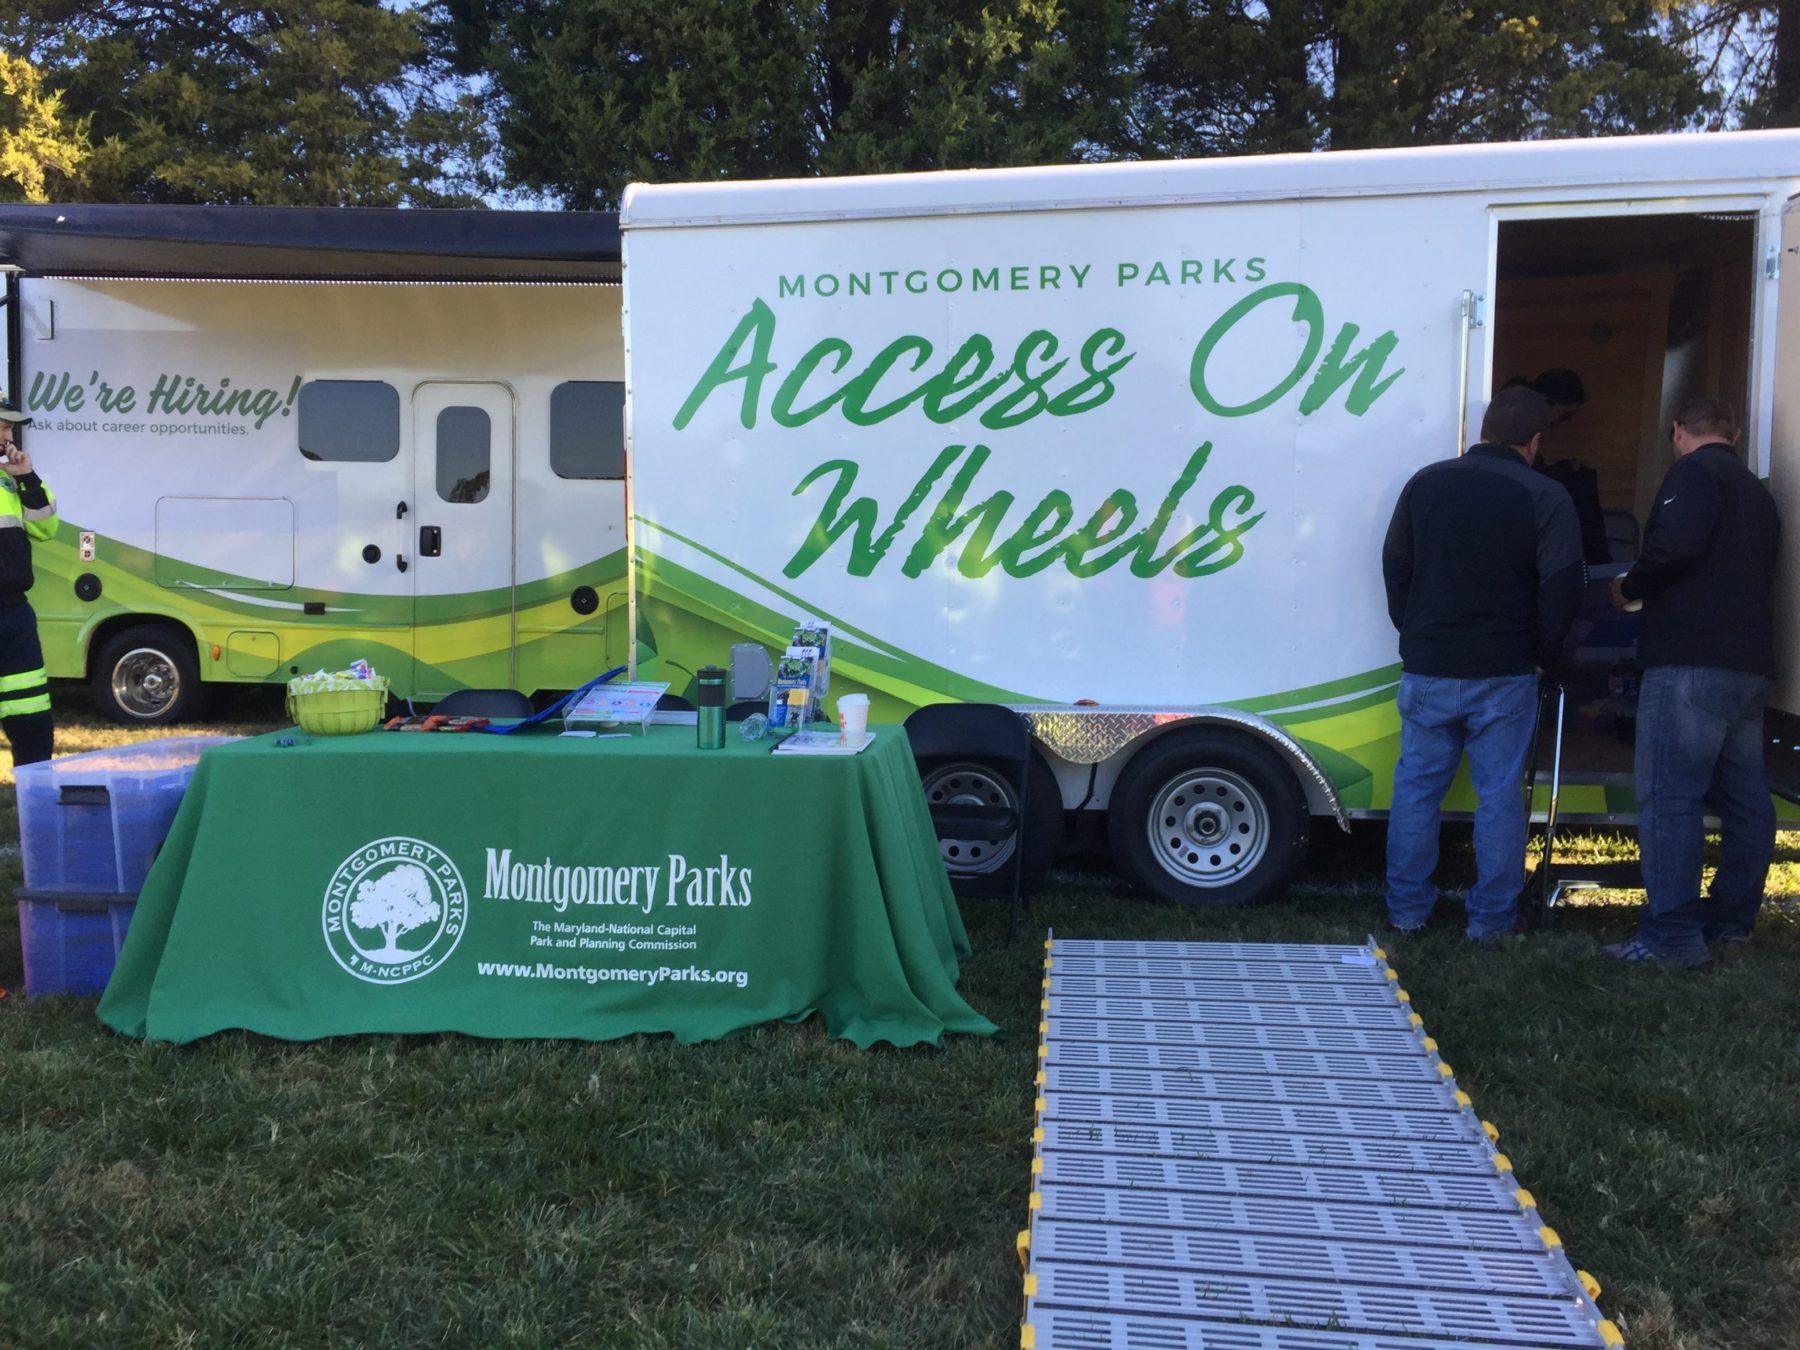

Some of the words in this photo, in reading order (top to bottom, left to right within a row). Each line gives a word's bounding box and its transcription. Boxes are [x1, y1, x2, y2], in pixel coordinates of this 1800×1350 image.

[778, 264, 1092, 299] MONTGOMERY
[1117, 256, 1267, 288] PARKS
[672, 296, 1138, 431] Access
[1189, 281, 1406, 418] On
[27, 370, 137, 415] We're
[146, 373, 303, 431] Hiring!
[27, 417, 53, 431] Ask
[57, 418, 98, 433] about
[102, 422, 146, 434] career
[149, 422, 249, 437] opportunities.
[781, 440, 1268, 580] Wheels
[326, 841, 438, 934] MONTGOMERY
[436, 863, 464, 938] PARKS
[483, 847, 660, 915] Montgomery
[665, 853, 752, 907] Parks
[530, 935, 553, 948] Park
[555, 936, 576, 949] and
[579, 937, 626, 952] Planning
[628, 938, 697, 951] Commission
[532, 920, 552, 933] The
[553, 921, 654, 936] Maryland-National
[656, 923, 697, 938] Capital
[359, 954, 435, 978] M-NCPPC
[477, 961, 749, 988] www.MontgomeryParks.org
